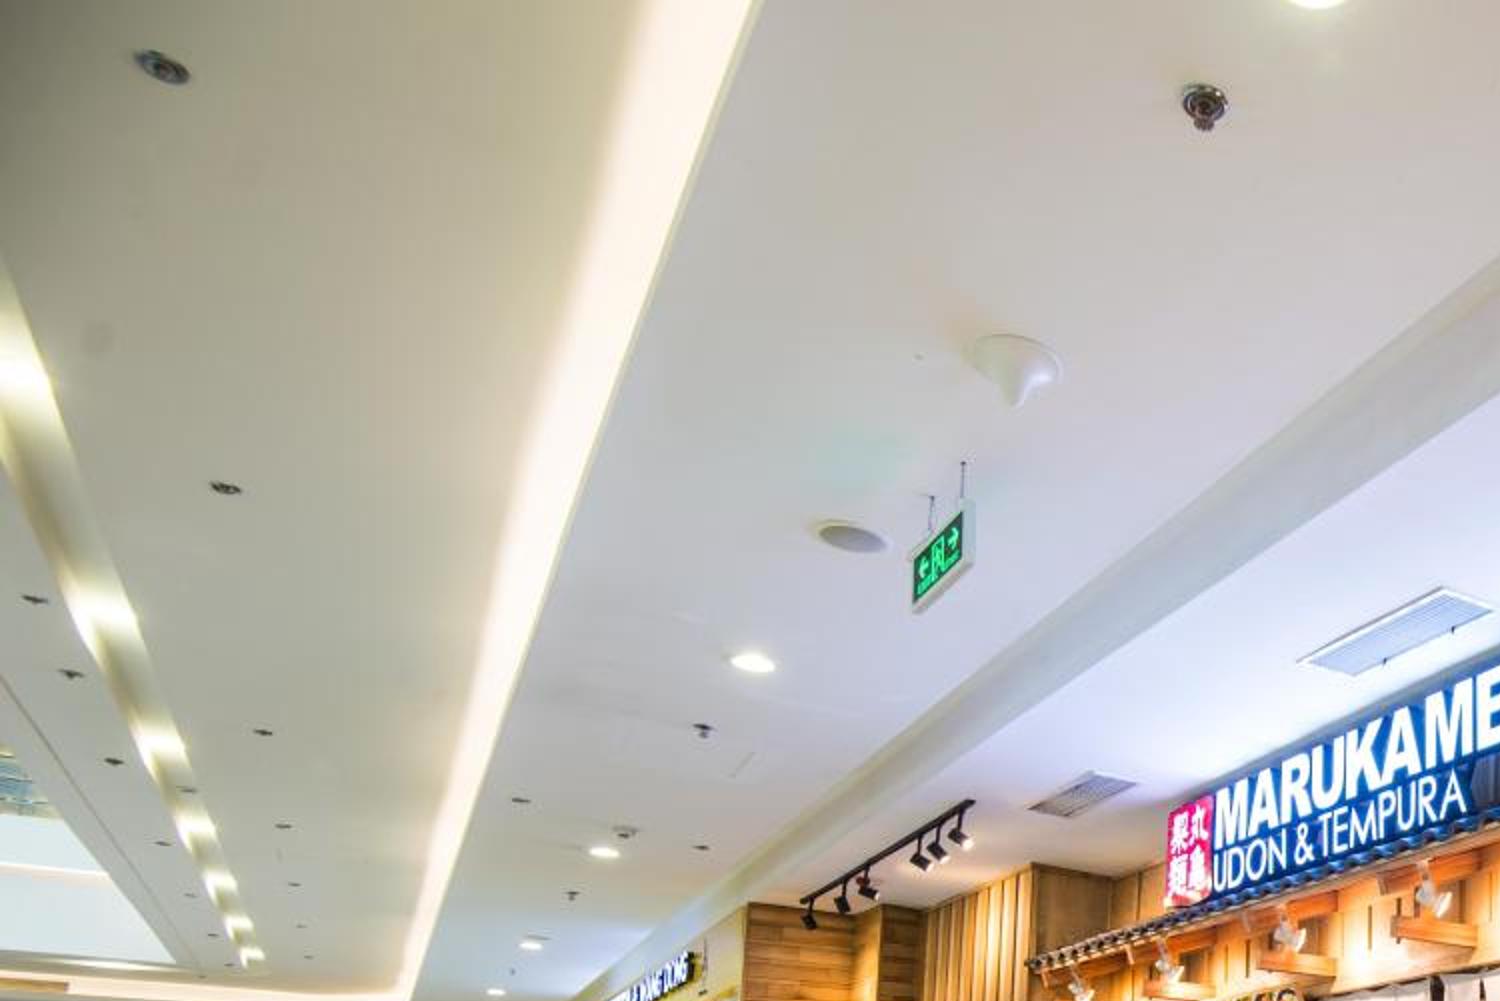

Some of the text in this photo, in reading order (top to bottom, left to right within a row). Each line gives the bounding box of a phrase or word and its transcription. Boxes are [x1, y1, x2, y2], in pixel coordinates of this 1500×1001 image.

[1213, 771, 1467, 893] UDON & TEMPURA
